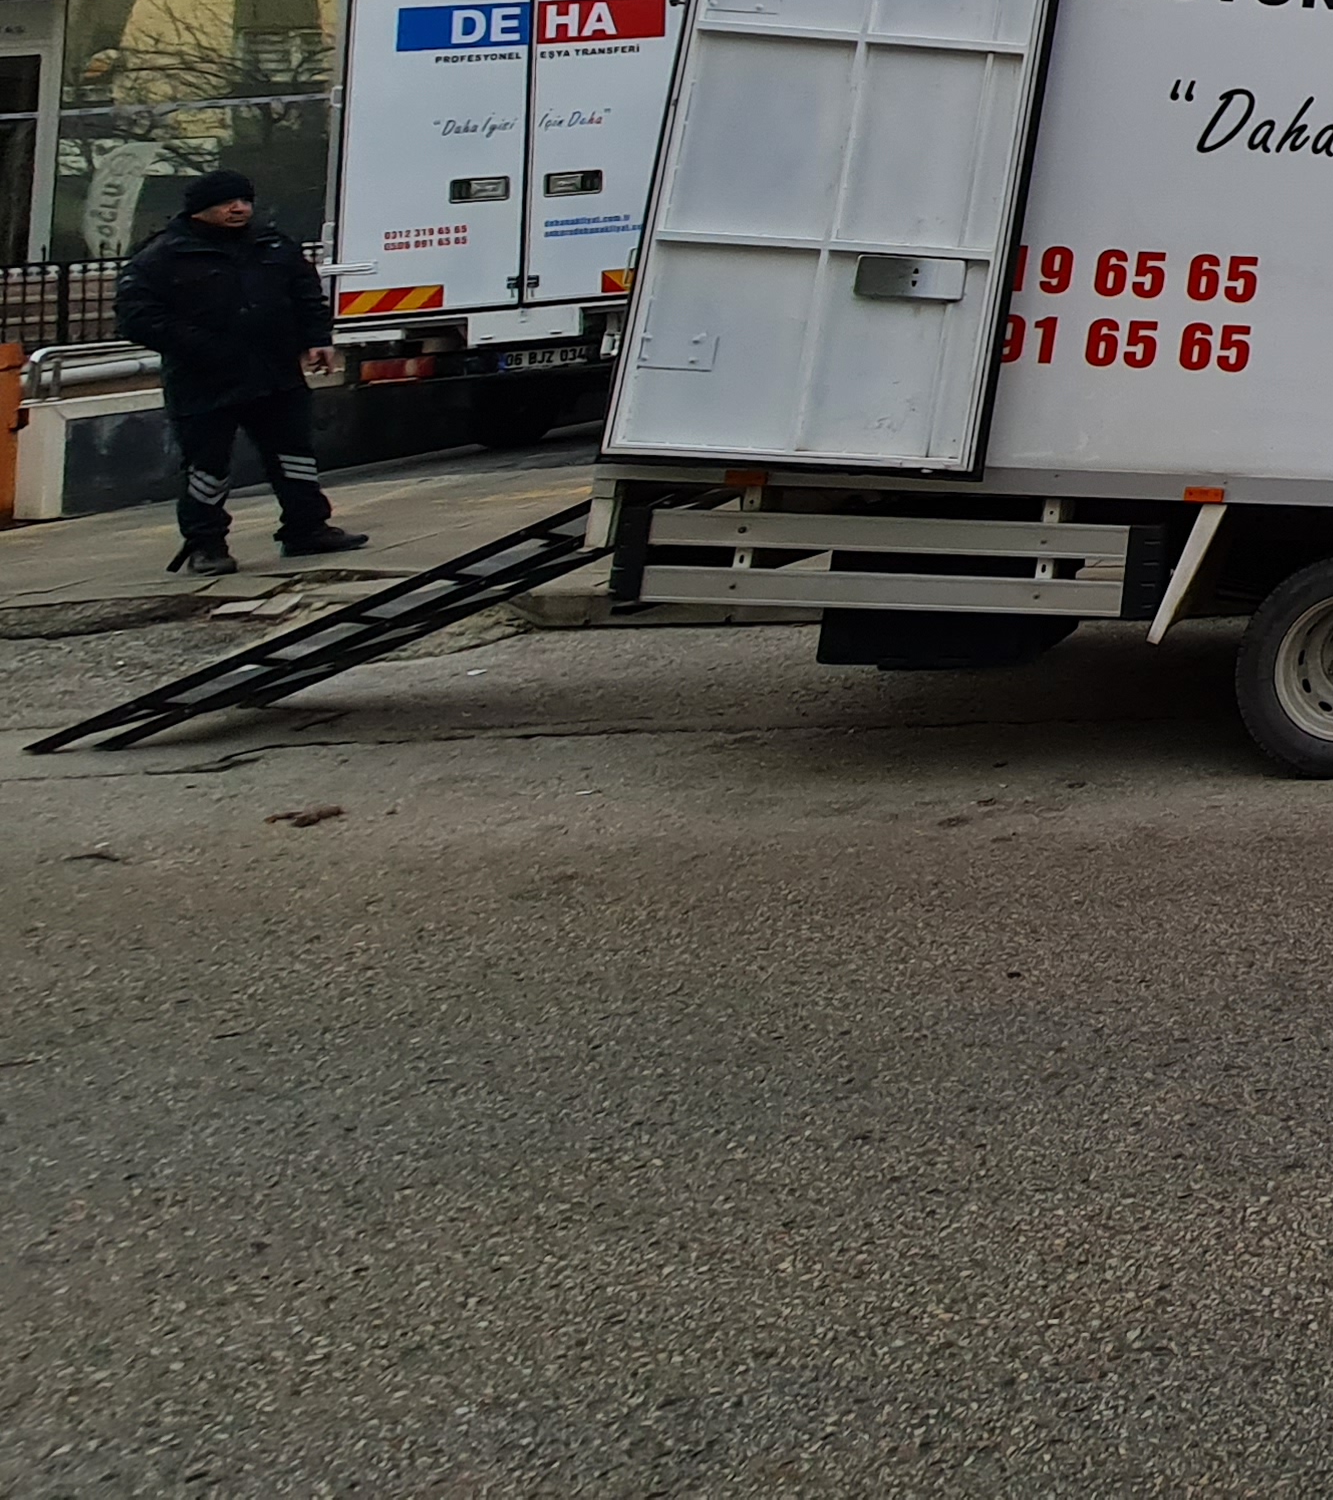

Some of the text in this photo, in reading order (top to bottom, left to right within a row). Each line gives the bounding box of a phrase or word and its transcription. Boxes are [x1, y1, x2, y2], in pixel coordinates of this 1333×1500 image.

[434, 51, 522, 63] PROFESYONEL
[575, 43, 640, 57] TRANSFERİ
[414, 227, 435, 238] 319
[1093, 248, 1167, 299] 65
[1186, 253, 1259, 304] 65
[1084, 318, 1159, 370] 65
[1178, 321, 1252, 373] 65
[507, 353, 523, 367] 06
[528, 350, 556, 366] BJZ
